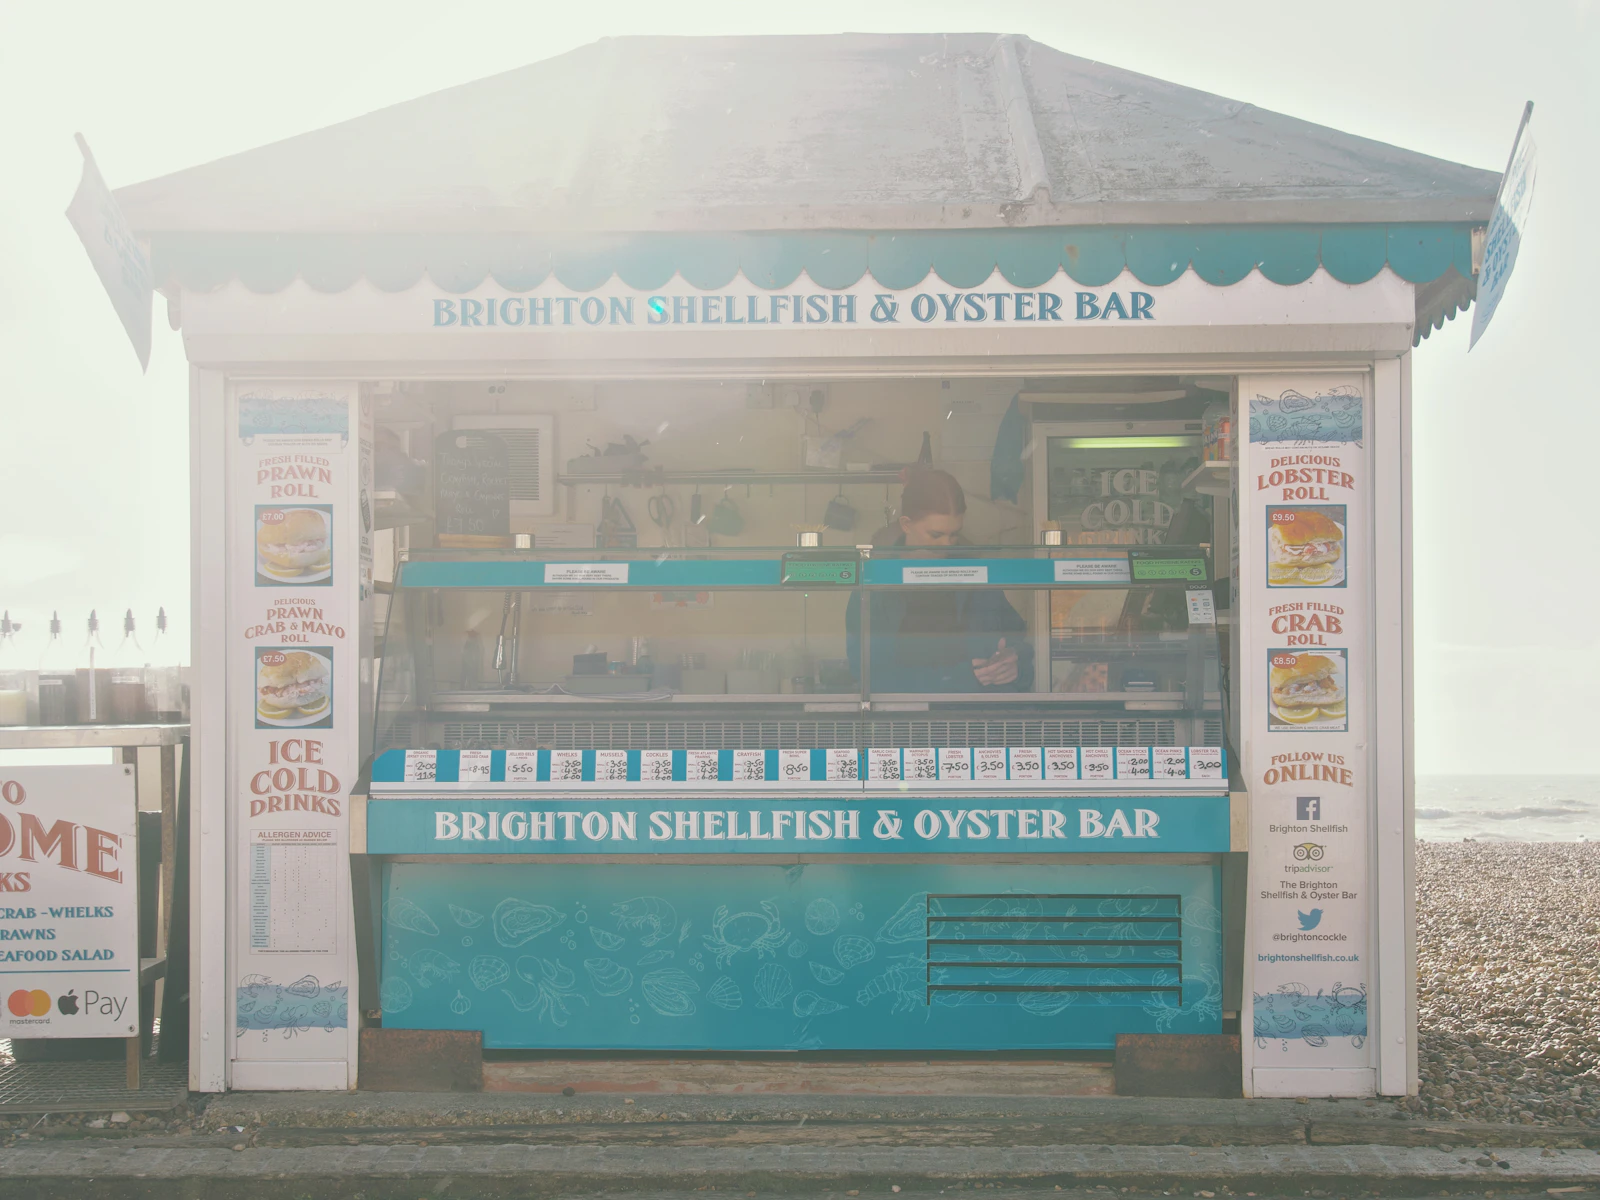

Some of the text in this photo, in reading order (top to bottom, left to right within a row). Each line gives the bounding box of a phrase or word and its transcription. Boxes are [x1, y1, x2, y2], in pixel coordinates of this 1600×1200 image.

[432, 291, 1156, 328] BRIGHTON SHELLFISH & OYSTER BAR
[258, 455, 330, 468] FRESH FILLED
[1270, 455, 1340, 468] DELICIOUS
[257, 465, 332, 486] PRAWN
[1100, 468, 1160, 496] ICE
[1257, 468, 1355, 490] LOBSTER
[270, 483, 318, 498] ROLL
[1282, 486, 1329, 500] ROLL
[1081, 499, 1174, 530] COLD
[266, 606, 324, 620] PRAWN
[1268, 602, 1344, 616] FRESH FILLED
[244, 621, 346, 639] CRAB & MAYO
[1271, 614, 1344, 634] CRAB
[281, 634, 309, 643] ROLL
[1287, 634, 1327, 646] ROLL
[263, 654, 284, 662] £7.50
[268, 739, 323, 765] ICE
[1271, 752, 1344, 765] FOLLOW US
[469, 766, 489, 774] £8.95
[508, 764, 533, 772] £5.50
[783, 763, 808, 775] £8.50
[941, 762, 969, 773] £7.50
[976, 761, 1004, 772] £3.50
[1012, 761, 1039, 771] £3.50
[1047, 761, 1074, 770] £3.50
[1085, 763, 1109, 771] £3.50
[1128, 767, 1150, 776] £4.00
[1194, 761, 1222, 769] £3.00
[250, 768, 341, 795] COLD
[1263, 764, 1353, 787] ONLINE
[0, 780, 26, 806] O
[250, 794, 341, 818] DRINKS
[433, 809, 1161, 841] BRIGHTON SHELLFISH & OYSTER BAR
[1269, 825, 1307, 834] Brighton
[1284, 865, 1331, 874] tripadvisor
[1300, 881, 1337, 890] Brighton
[1260, 891, 1298, 899] Shellfish
[1310, 892, 1339, 900] Oyster
[1272, 933, 1347, 942] @brightoncockle
[62, 949, 114, 961] SALAD
[1258, 954, 1360, 963] brightonshellfish.co.uk
[85, 990, 127, 1021] Pay
